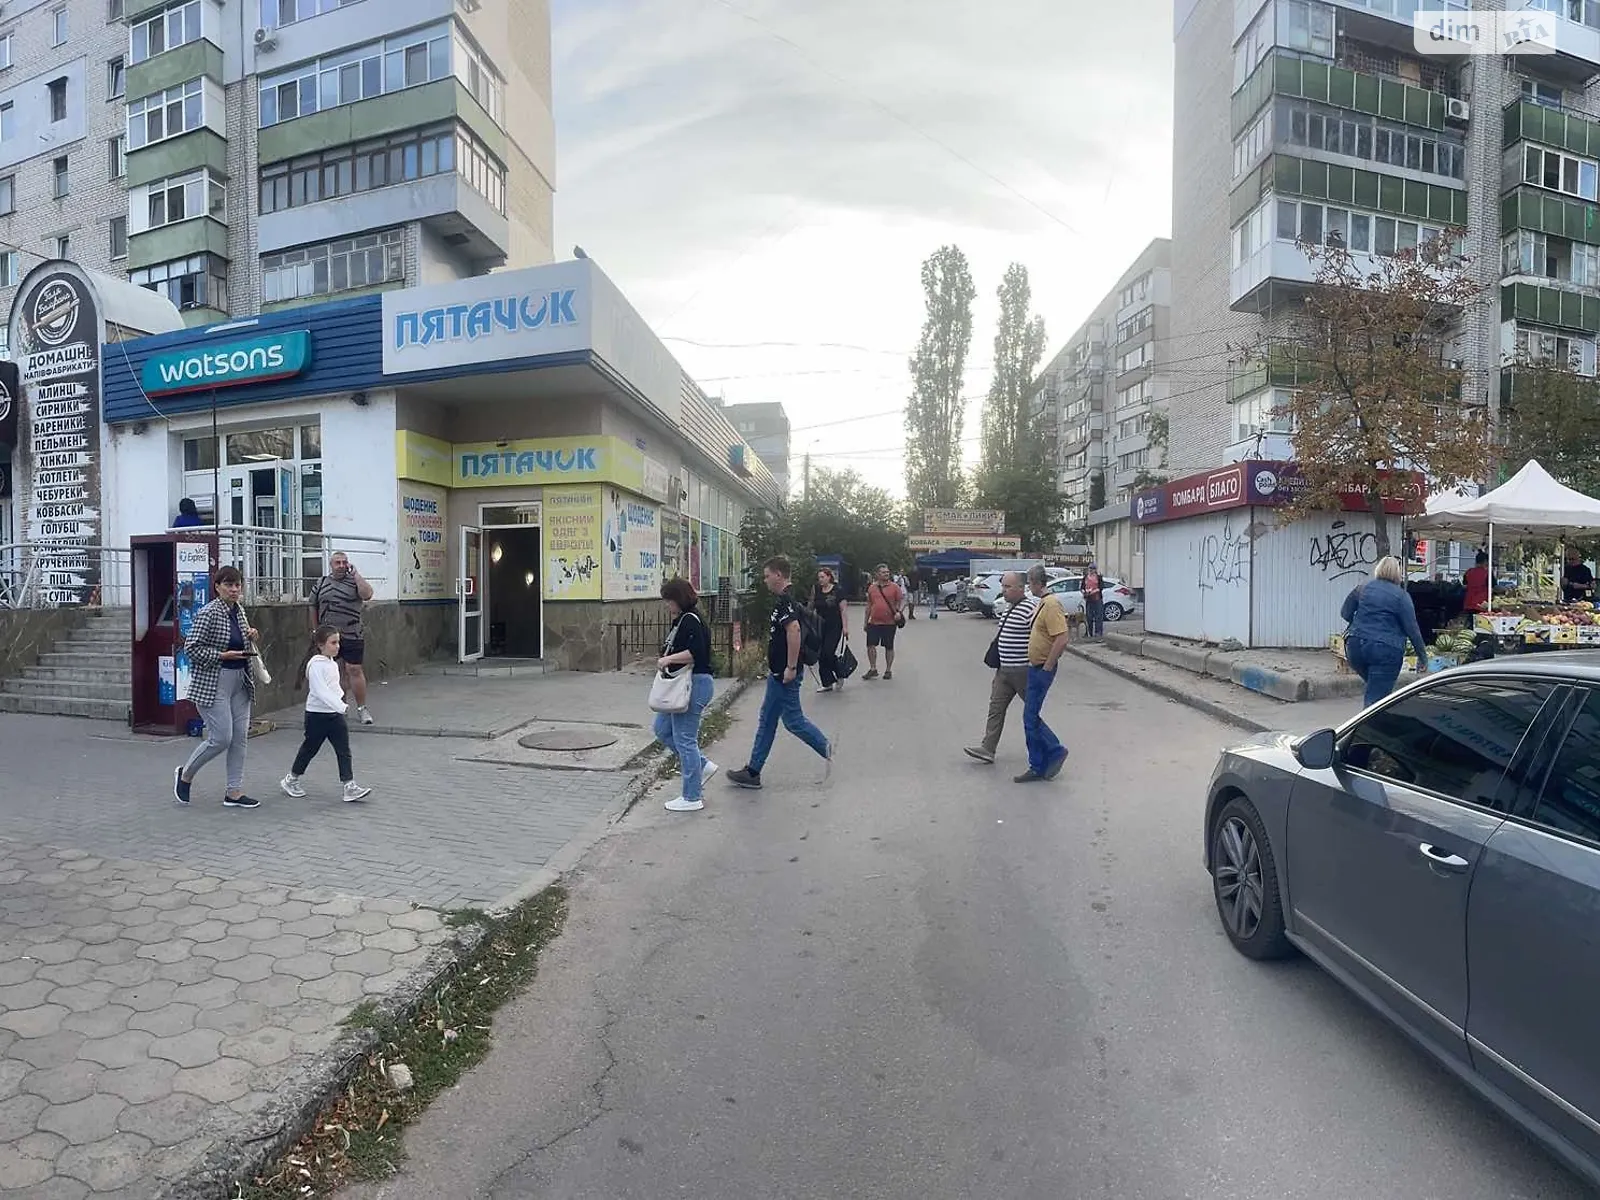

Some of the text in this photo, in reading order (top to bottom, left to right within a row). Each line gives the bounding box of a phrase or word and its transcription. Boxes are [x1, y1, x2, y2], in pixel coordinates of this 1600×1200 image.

[395, 287, 577, 351] ПЯТАЧОК
[28, 345, 89, 371] ДОМАШНІ
[159, 344, 285, 383] watsons
[24, 361, 93, 380] НАПІВФАБРИКАТИ
[38, 383, 76, 400] МЛИНЦІ
[36, 400, 79, 417] СИРНИКИ
[34, 416, 83, 434] ВАРЕНИКИ
[35, 434, 82, 451] ПЕЛЬМЕНІ
[40, 452, 78, 467] ХІНКАЛІ
[461, 446, 597, 480] ПЯТАЧОК
[39, 470, 79, 485] КОТЛЕТИ
[37, 486, 83, 501] ЧЕБУРЕКИ
[1172, 477, 1238, 507] ЛОМБАРД БЛАГО
[36, 503, 83, 519] КОВБАСКИ
[41, 522, 79, 535] ГОЛУБЦІ
[49, 573, 72, 585] ПІЦА
[48, 590, 72, 602] СУПИ
